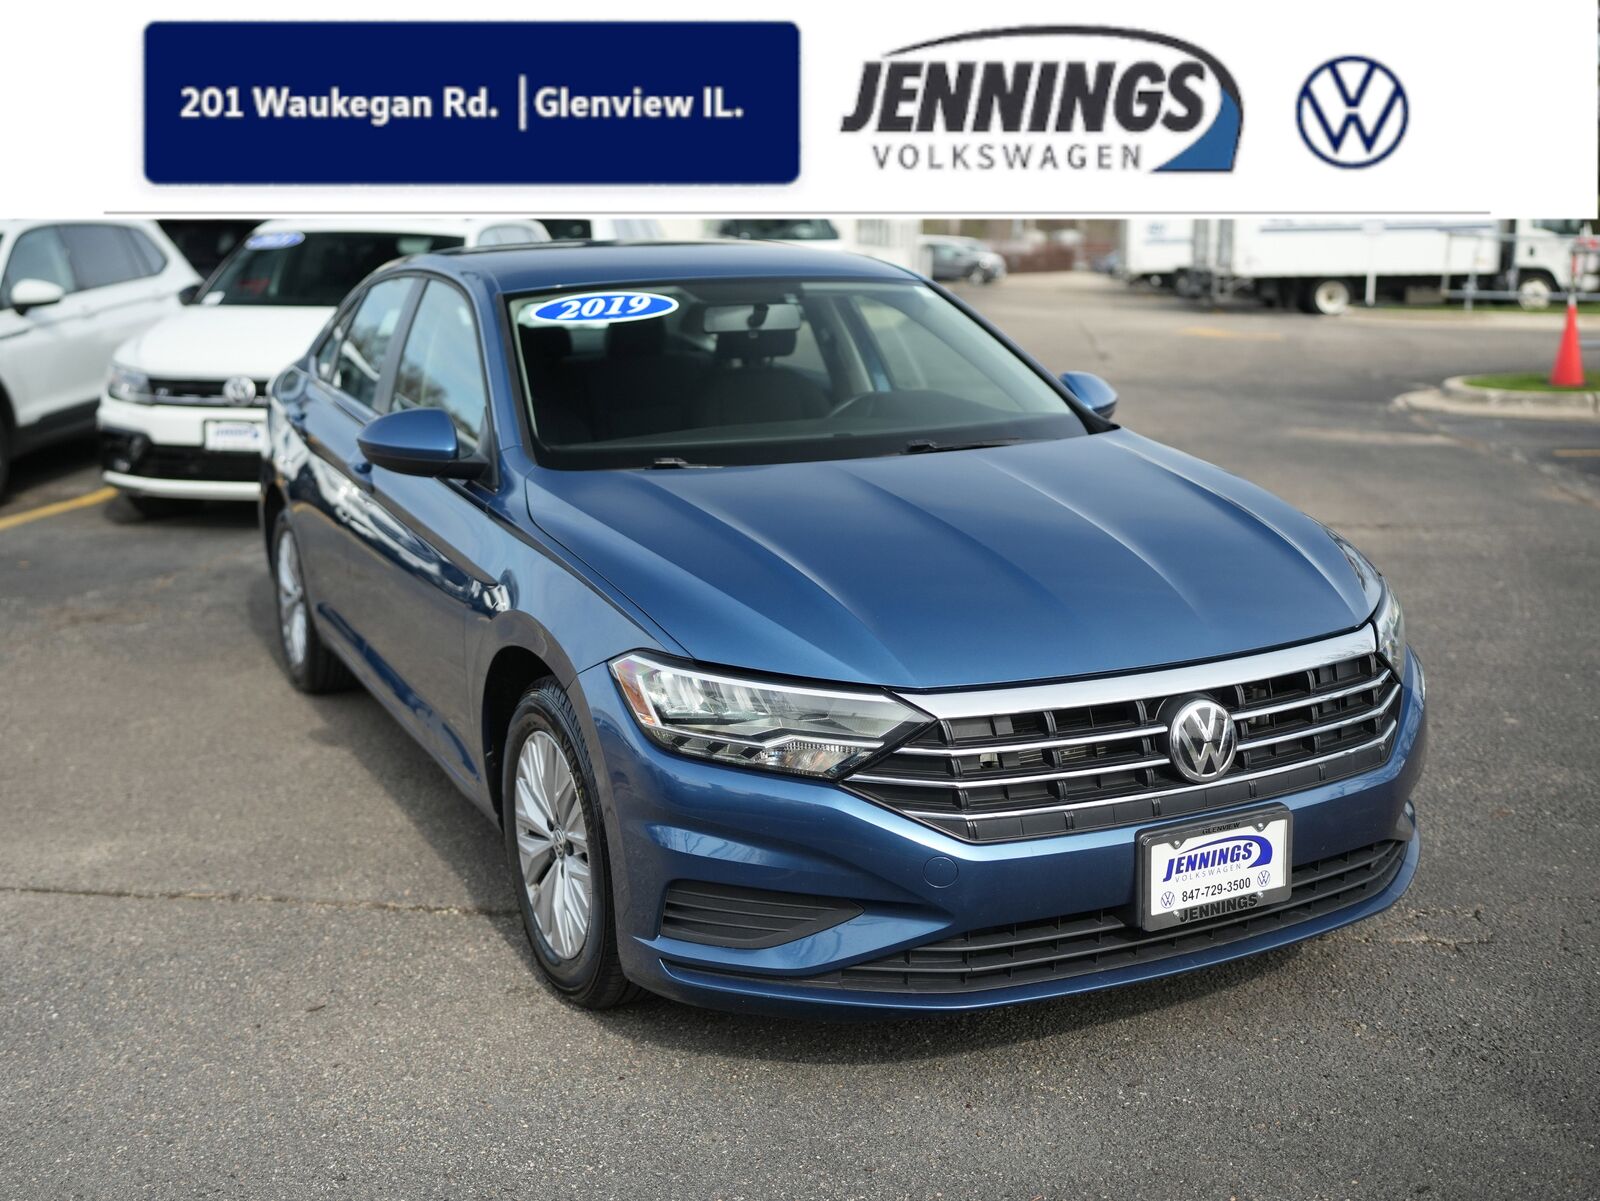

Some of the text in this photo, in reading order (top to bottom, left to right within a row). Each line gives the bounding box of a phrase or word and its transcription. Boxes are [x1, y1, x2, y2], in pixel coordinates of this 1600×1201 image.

[556, 296, 652, 320] 2019
[1202, 822, 1241, 835] GLENVIEW
[1163, 842, 1253, 883] JENNINGS
[1175, 863, 1241, 883] VOLKSWAGEN
[1182, 877, 1251, 903] 847-729-3500
[1180, 893, 1258, 923] JENNINGS
